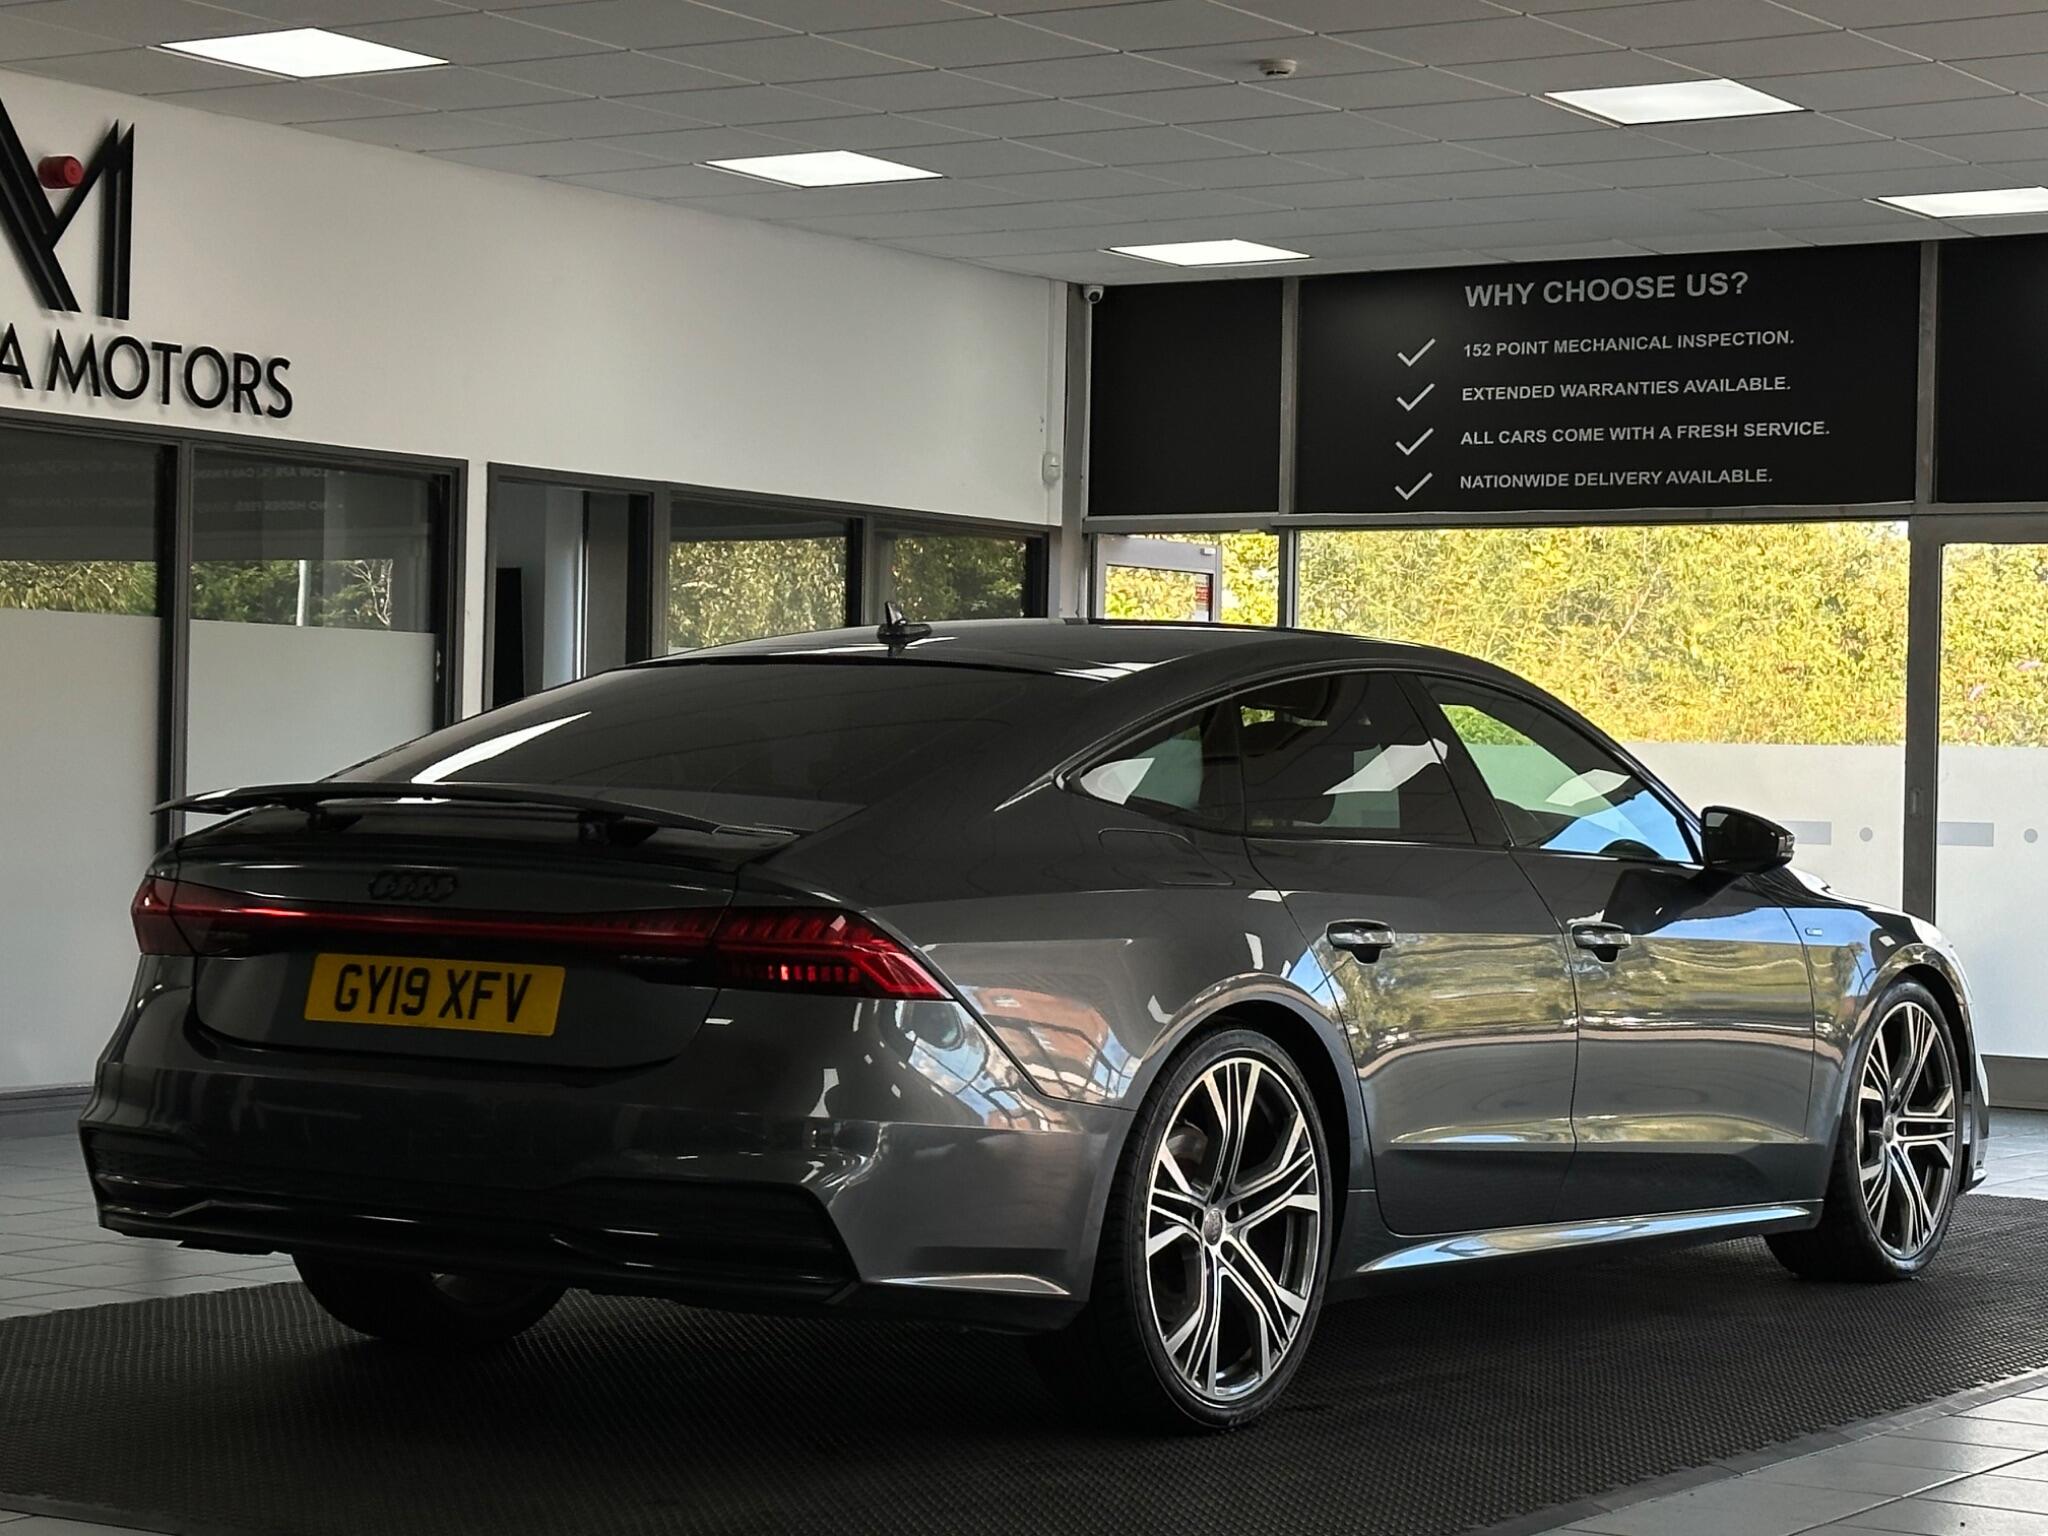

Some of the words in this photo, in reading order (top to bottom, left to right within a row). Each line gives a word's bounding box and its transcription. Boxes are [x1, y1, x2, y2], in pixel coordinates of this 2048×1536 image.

[1465, 283, 1534, 307] WHY
[1544, 276, 1675, 303] CHOOSE
[1687, 272, 1748, 296] US?
[1464, 343, 1491, 357] 152
[1497, 341, 1549, 355] POINT
[1554, 336, 1672, 353] MECHANICAL
[1678, 331, 1794, 348] INSPECTION.
[46, 329, 293, 418] MOTORS
[1463, 385, 1555, 401] EXTENDED
[1560, 381, 1679, 397] WARRANTIES
[1683, 377, 1790, 393] AVAILABLE.
[1461, 432, 1494, 445] ALL
[1499, 430, 1546, 443] CARS
[1553, 428, 1604, 442] COME
[1610, 427, 1654, 440] WITH
[1658, 426, 1673, 440] A
[1677, 424, 1737, 438] FRESH
[1744, 421, 1829, 437] SERVICE.
[1461, 474, 1568, 488] NATIONWIDE
[1575, 472, 1662, 486] DELIVERY
[1666, 469, 1772, 484] AVAILABLE.
[334, 963, 431, 1017] GY19
[437, 968, 532, 1024] XFV
